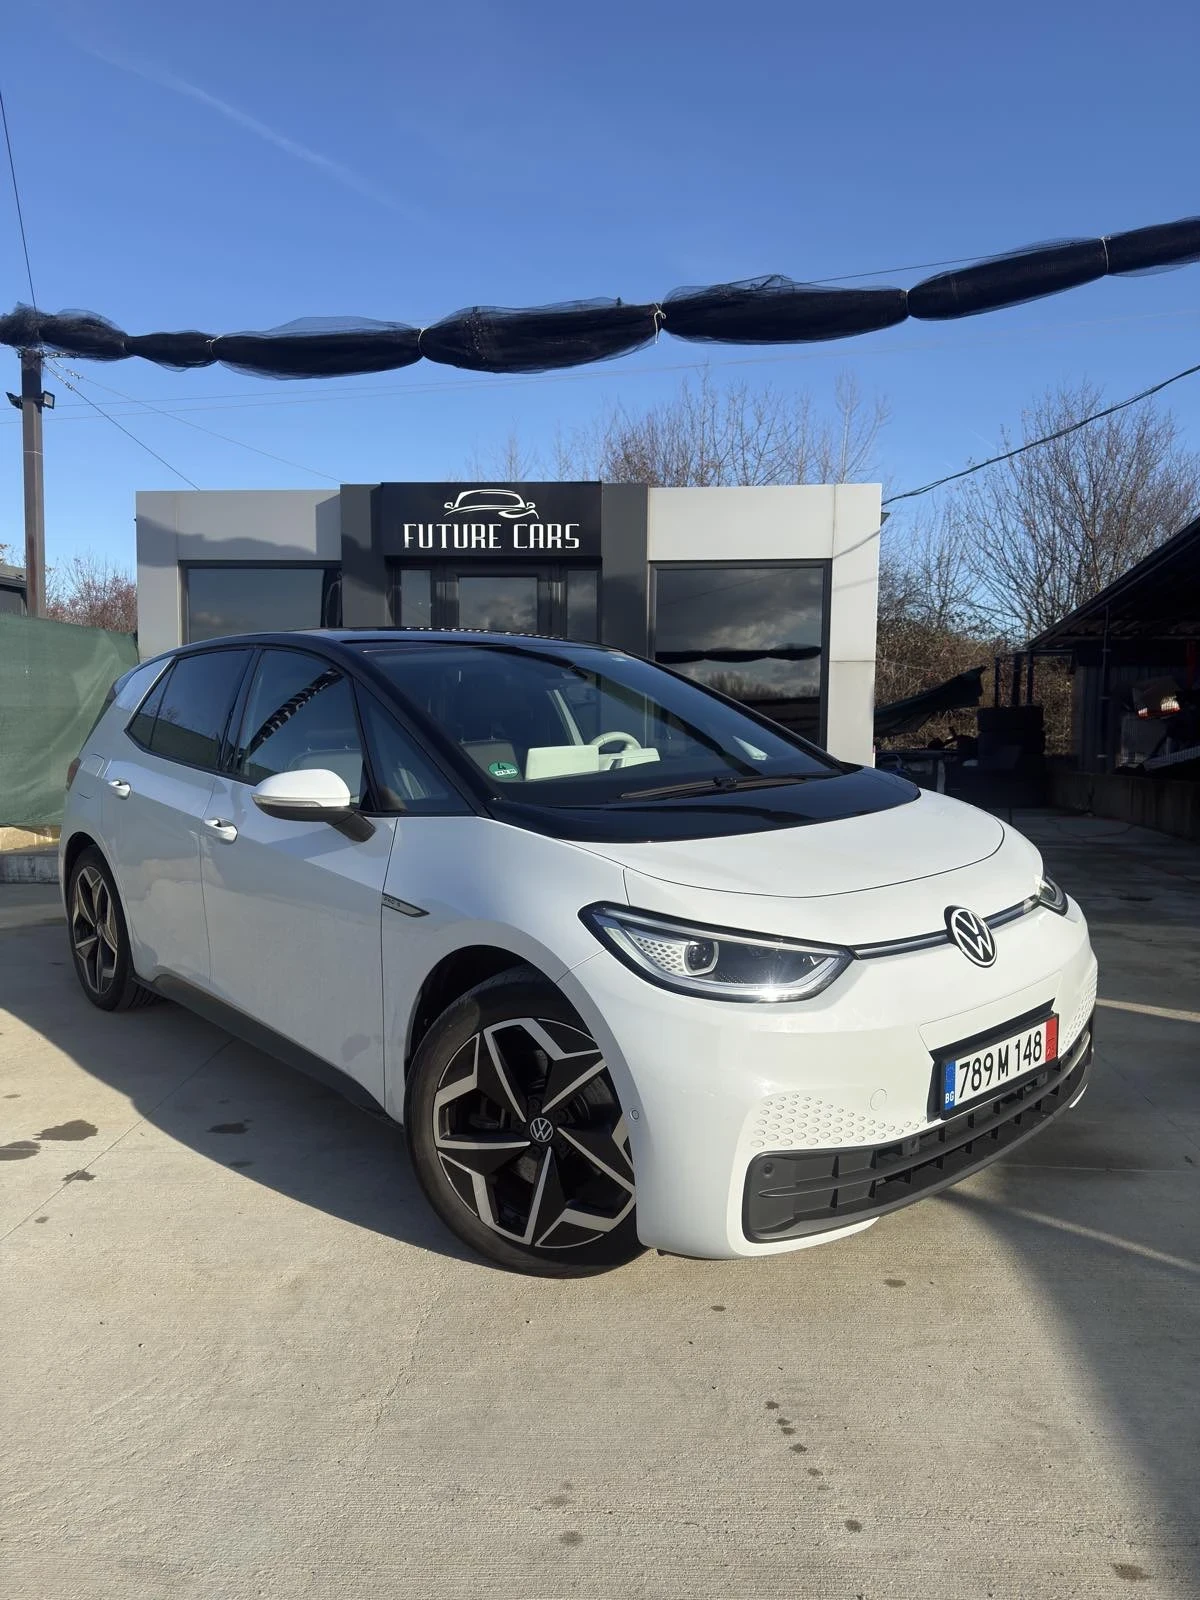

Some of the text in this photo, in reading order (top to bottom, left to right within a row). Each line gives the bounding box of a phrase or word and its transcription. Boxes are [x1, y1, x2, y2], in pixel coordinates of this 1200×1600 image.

[403, 523, 580, 549] FUTURE CARS
[952, 909, 995, 965] VW
[959, 1052, 994, 1098] 789
[998, 1047, 1009, 1081] M
[1015, 1030, 1042, 1071] 148
[945, 1090, 955, 1104] BG
[530, 1117, 554, 1142] VW
